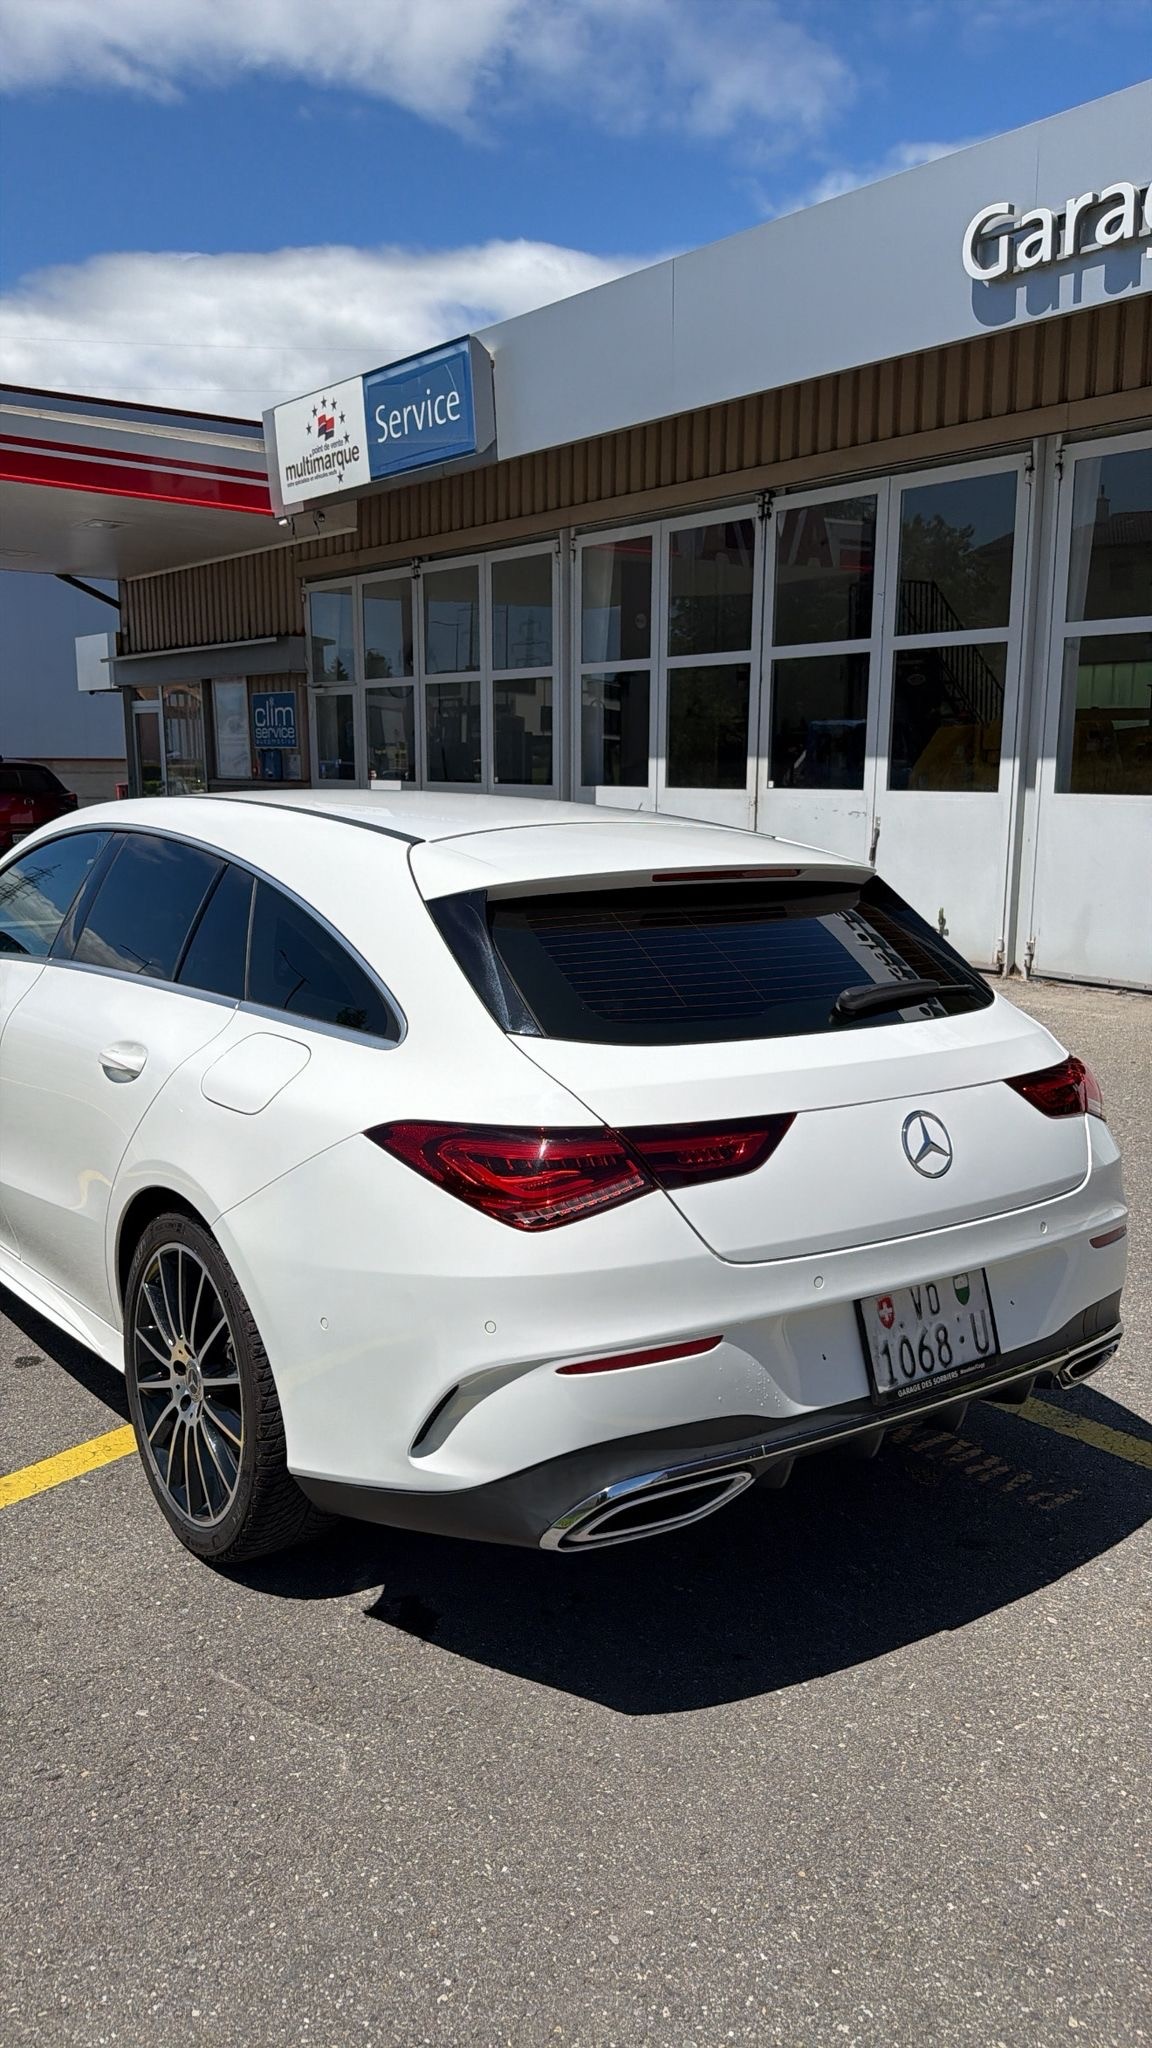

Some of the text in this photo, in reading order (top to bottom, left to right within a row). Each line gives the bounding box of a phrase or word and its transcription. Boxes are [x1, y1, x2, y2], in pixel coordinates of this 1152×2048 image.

[962, 181, 1152, 280] Gara
[375, 388, 461, 443] Service
[285, 445, 360, 481] multimarque
[311, 444, 323, 455] point
[255, 698, 294, 727] clim
[255, 726, 295, 739] service
[897, 1384, 921, 1398] GARAGE
[921, 1379, 933, 1390] DES
